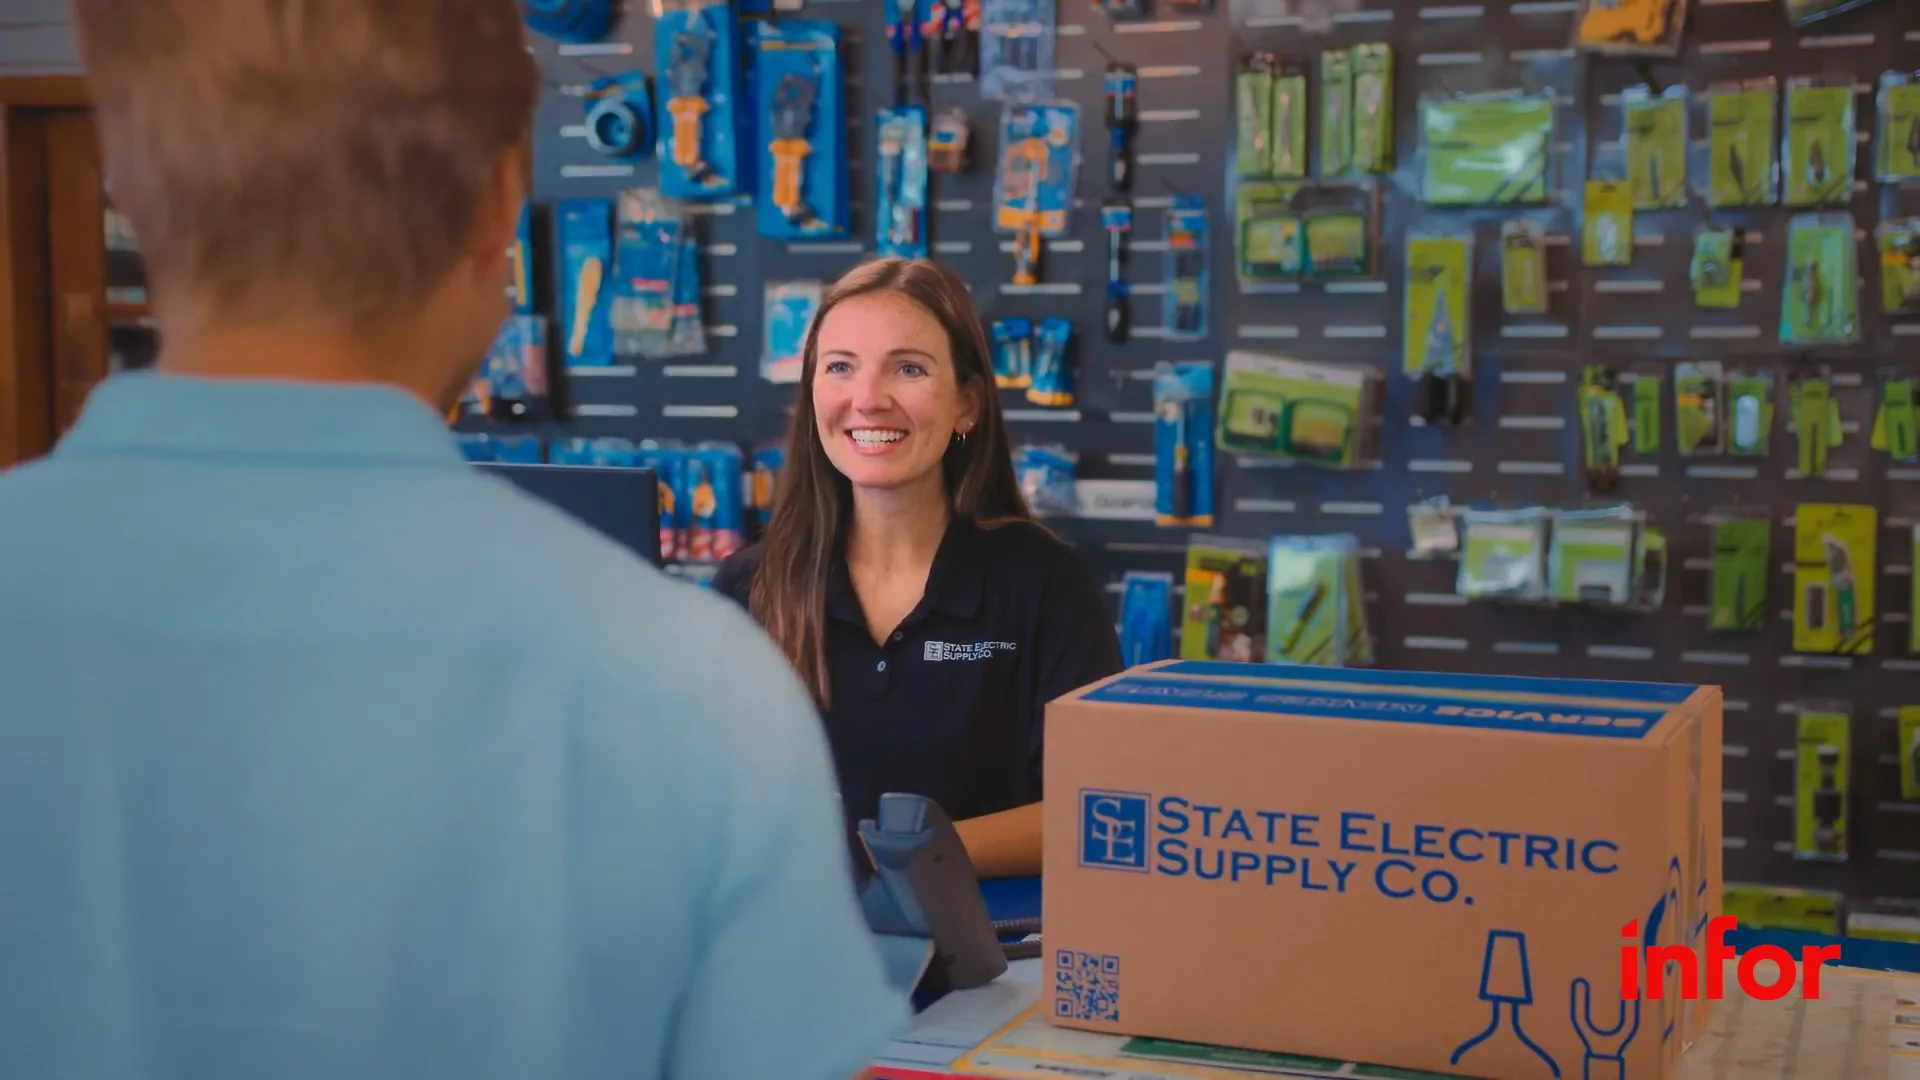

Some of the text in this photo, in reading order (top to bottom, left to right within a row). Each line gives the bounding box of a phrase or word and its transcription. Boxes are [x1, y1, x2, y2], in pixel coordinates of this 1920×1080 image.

[943, 642, 973, 652] STATE
[974, 641, 1017, 652] ELECTRIC
[943, 651, 978, 661] SUPPLY
[978, 649, 994, 659] CO.
[1157, 796, 1619, 874] STATE ELECTRIC
[1156, 837, 1474, 905] SUPPLY CO.
